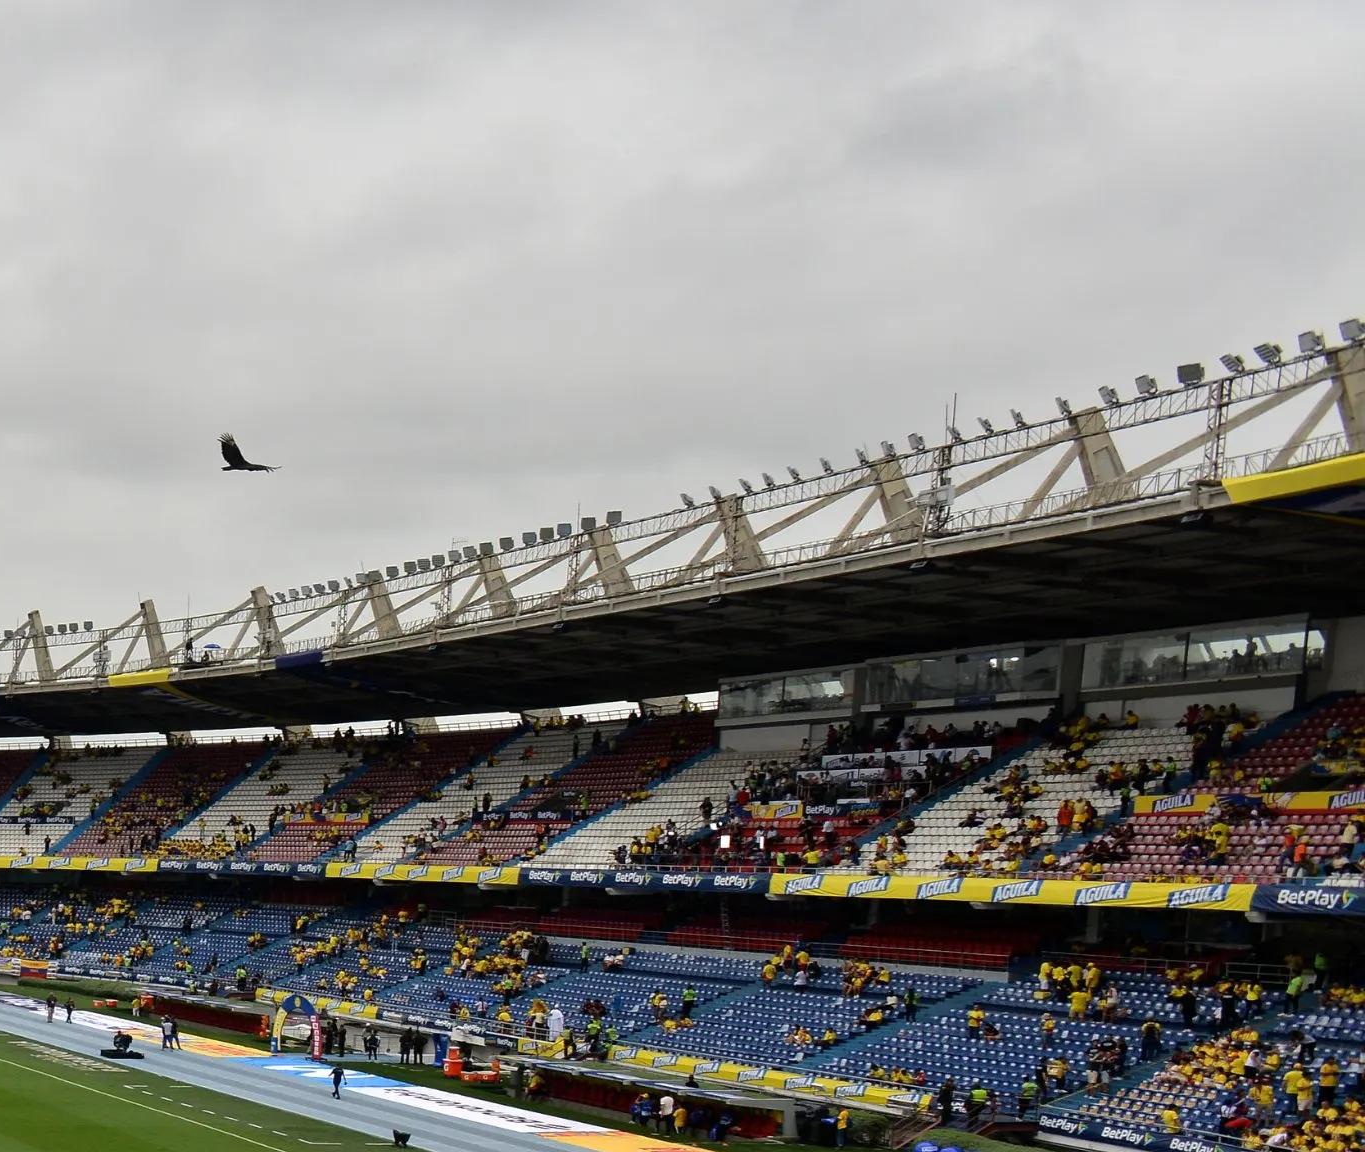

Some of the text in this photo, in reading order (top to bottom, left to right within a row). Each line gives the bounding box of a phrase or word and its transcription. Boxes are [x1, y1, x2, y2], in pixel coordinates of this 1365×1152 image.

[805, 804, 835, 816] BetPlay
[160, 861, 183, 869] BetPlay
[196, 861, 219, 870] BetPlay
[231, 862, 253, 871] BetPlay
[263, 863, 285, 872] BetPlay
[297, 864, 318, 873] BetPlay
[529, 870, 555, 882] BetPlay
[571, 871, 599, 883] BetPlay
[615, 872, 644, 885] BetPlay
[662, 874, 694, 886] BetPlay
[714, 875, 750, 888] BetPlay
[1277, 890, 1342, 909] BetPlay
[1039, 1115, 1079, 1134] BetPlay
[1101, 1126, 1144, 1144] BetPlay
